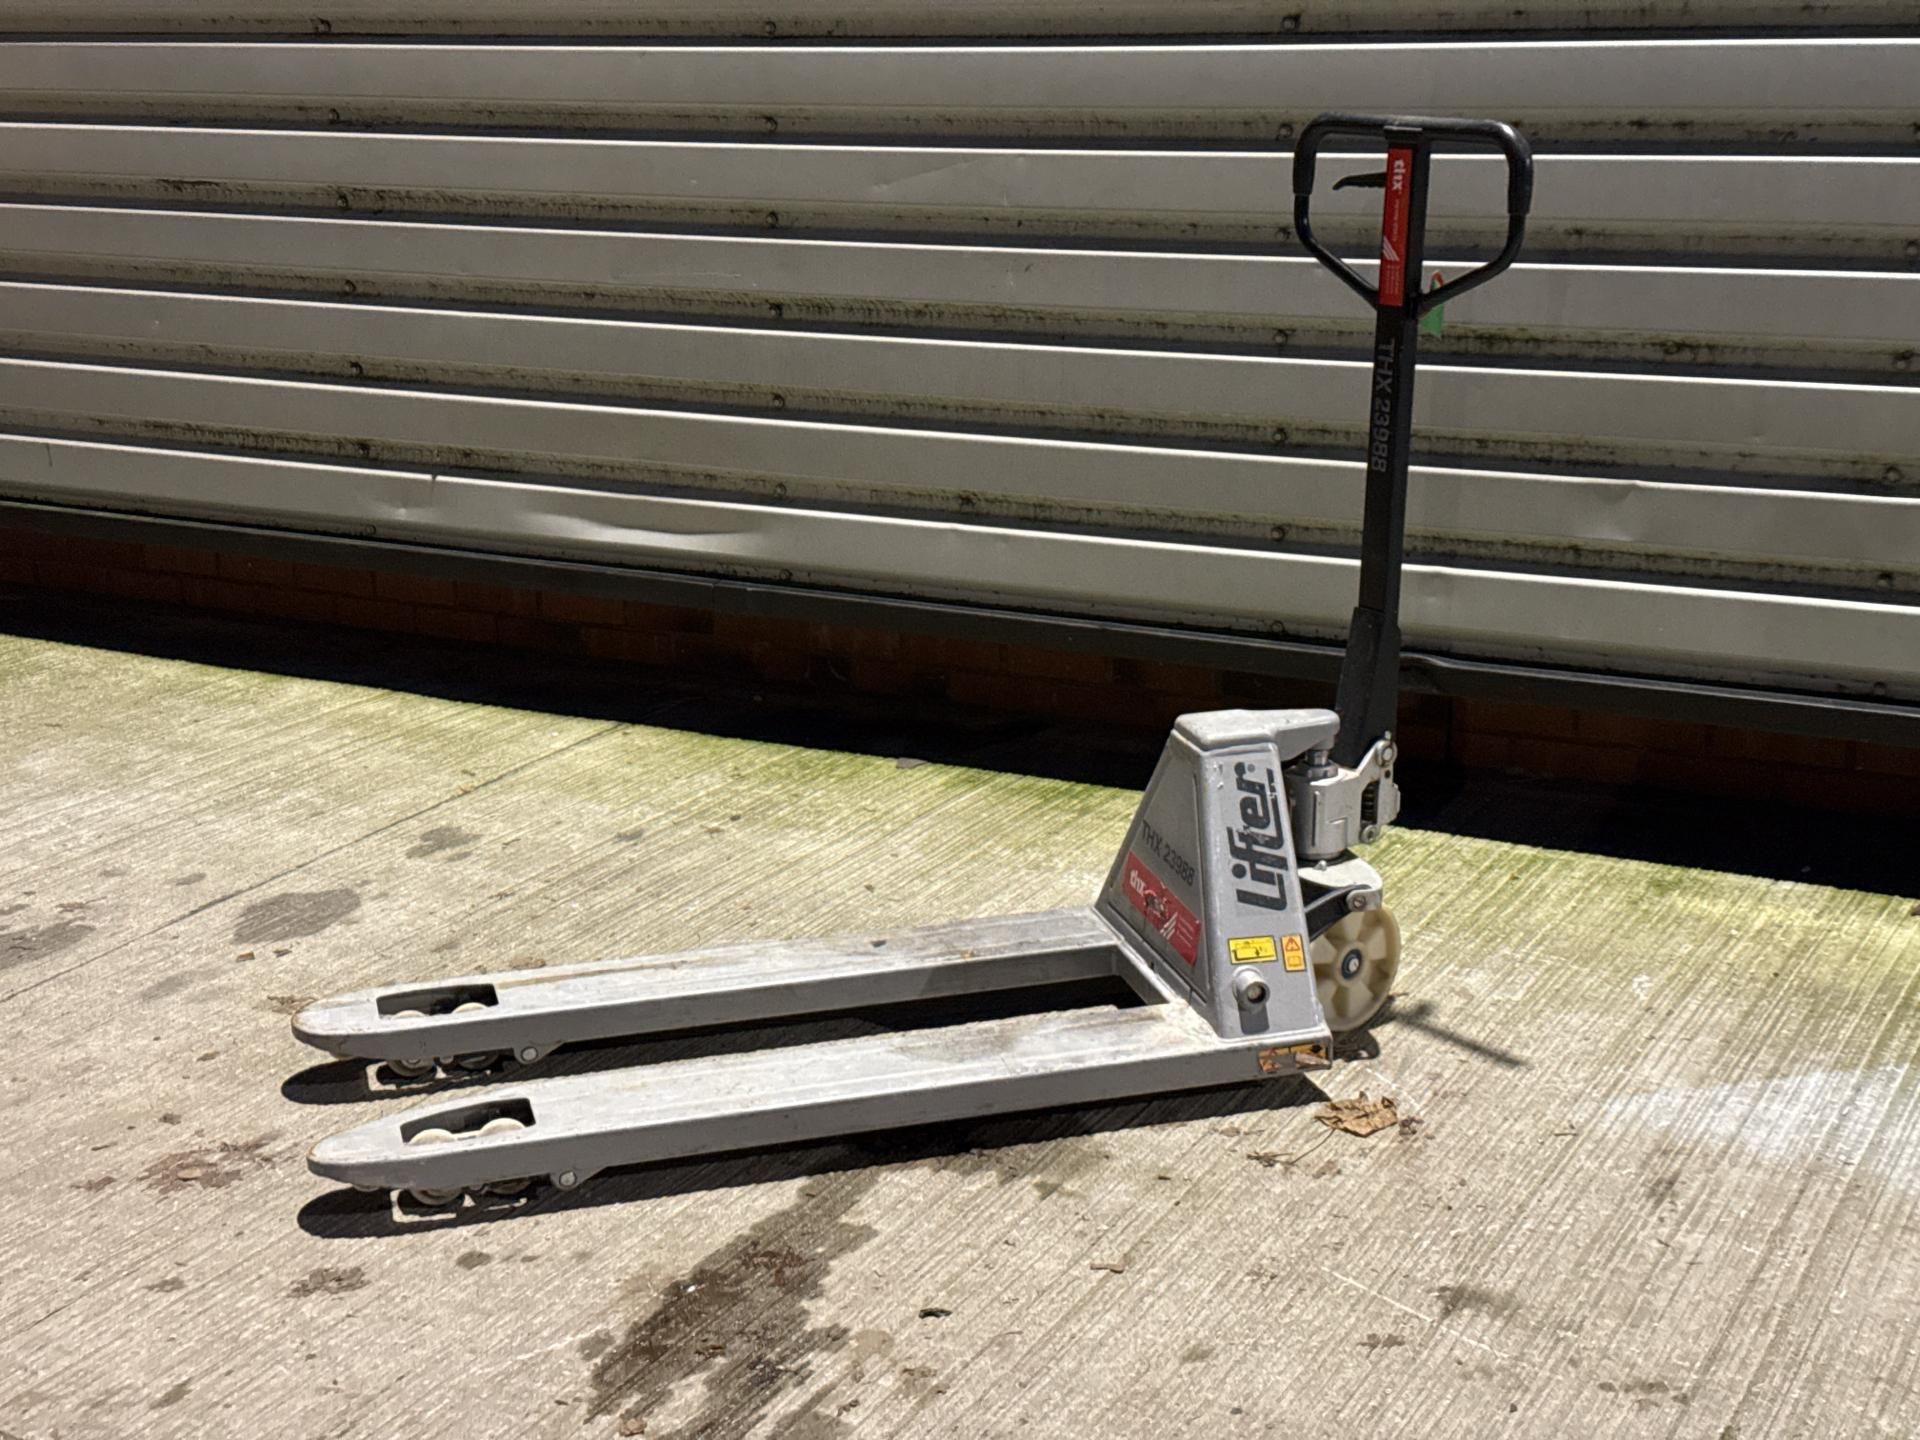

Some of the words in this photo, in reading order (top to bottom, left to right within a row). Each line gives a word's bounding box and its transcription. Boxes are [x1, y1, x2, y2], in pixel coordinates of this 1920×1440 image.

[1376, 337, 1395, 393] THX
[1371, 396, 1391, 473] 23988
[1141, 819, 1163, 858] THX
[1163, 843, 1195, 887] 23988
[1226, 761, 1289, 911] Lifter
[1129, 869, 1147, 897] thx
